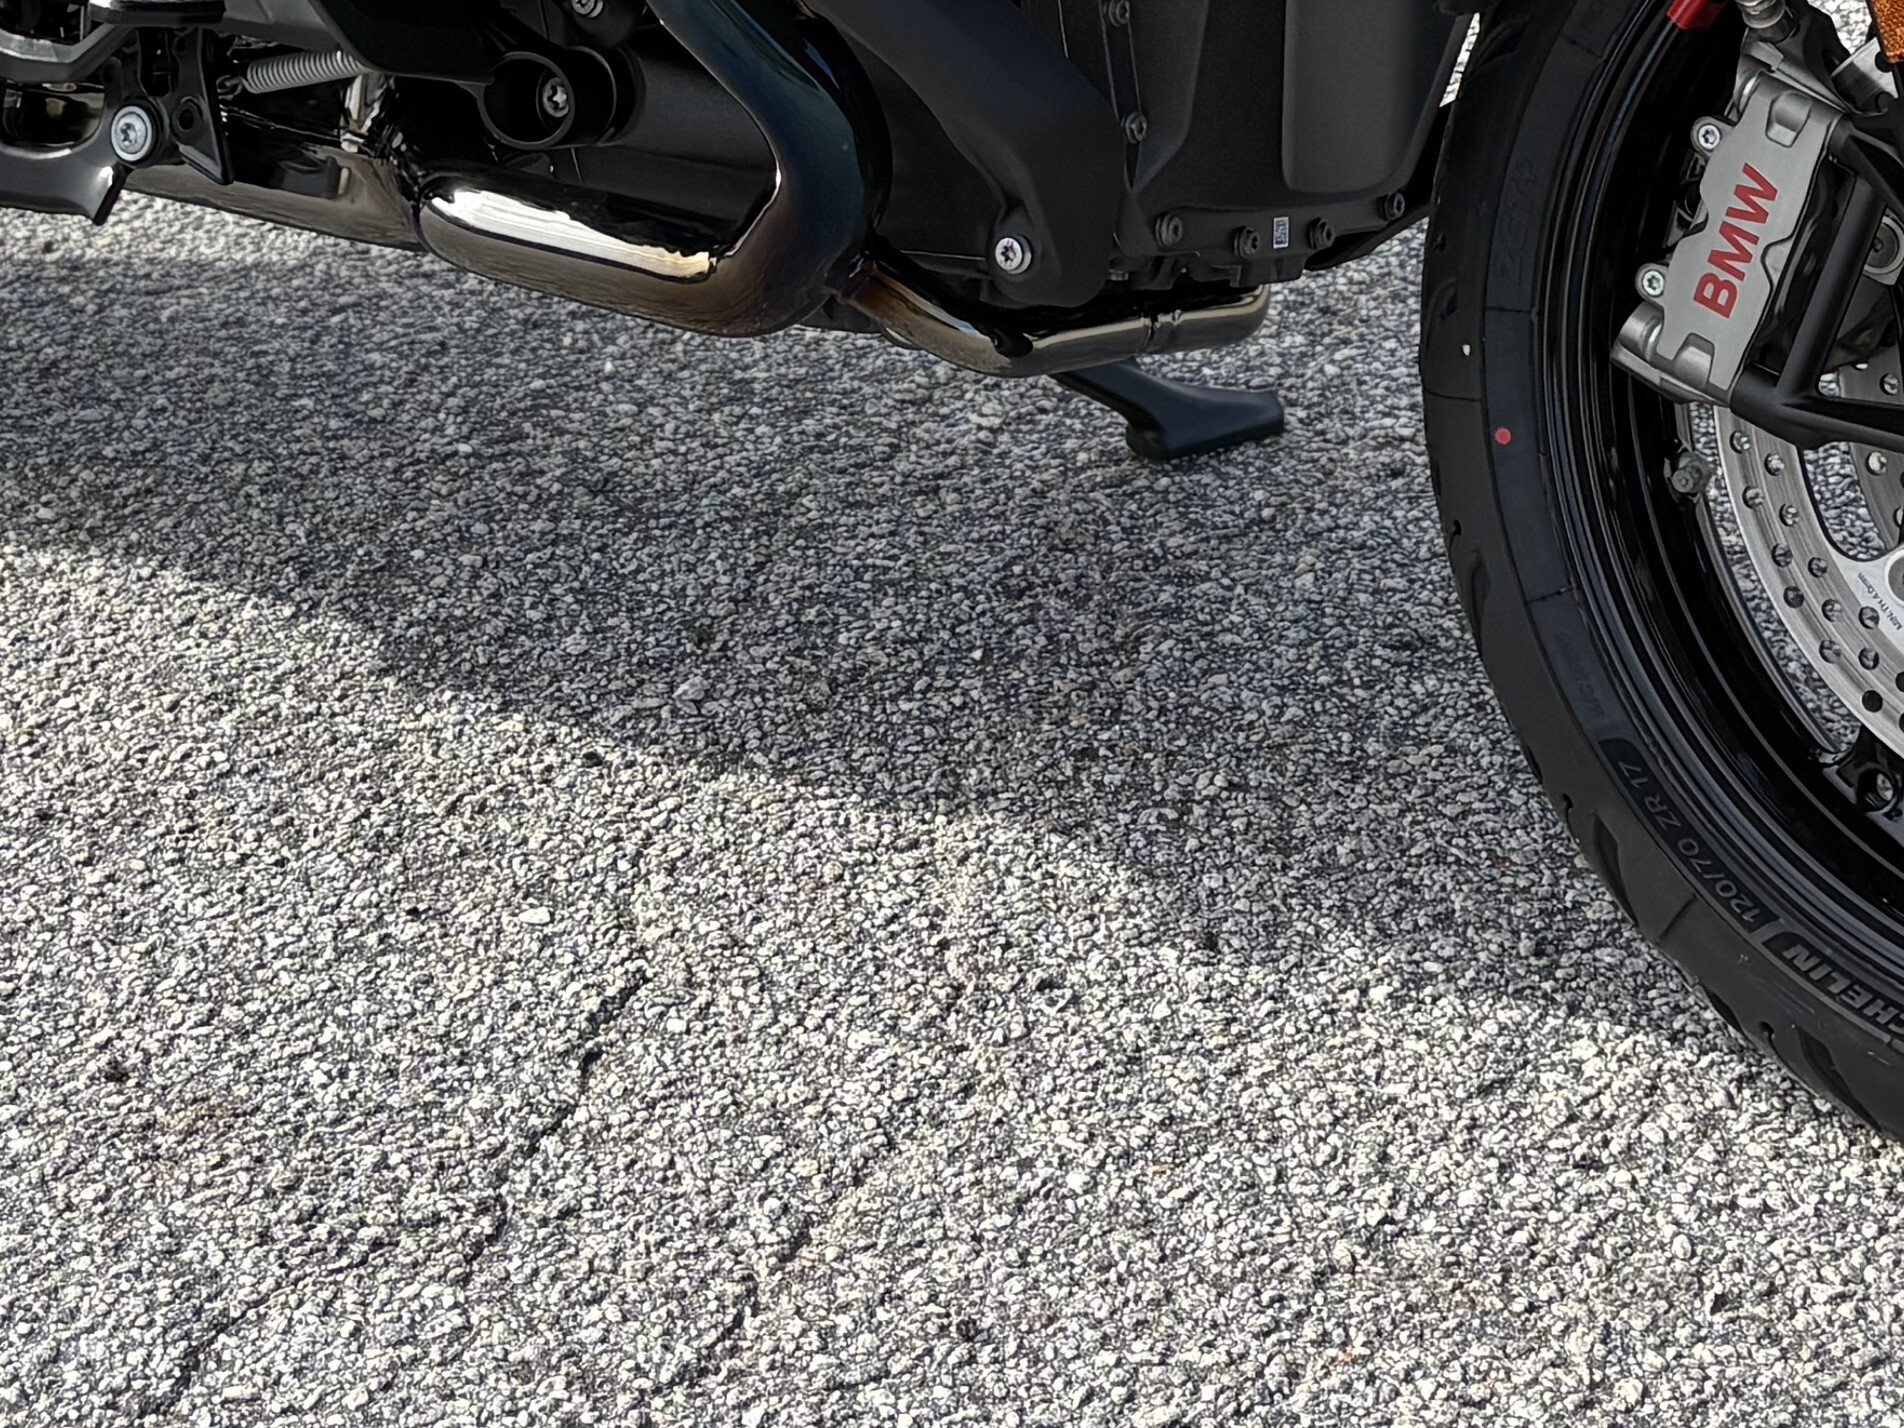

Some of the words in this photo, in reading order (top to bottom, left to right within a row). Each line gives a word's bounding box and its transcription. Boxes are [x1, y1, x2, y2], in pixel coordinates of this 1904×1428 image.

[1692, 161, 1779, 320] BMW
[1617, 760, 1649, 789] 17
[1645, 794, 1682, 831] ZR
[1678, 837, 1761, 923] 120/70
